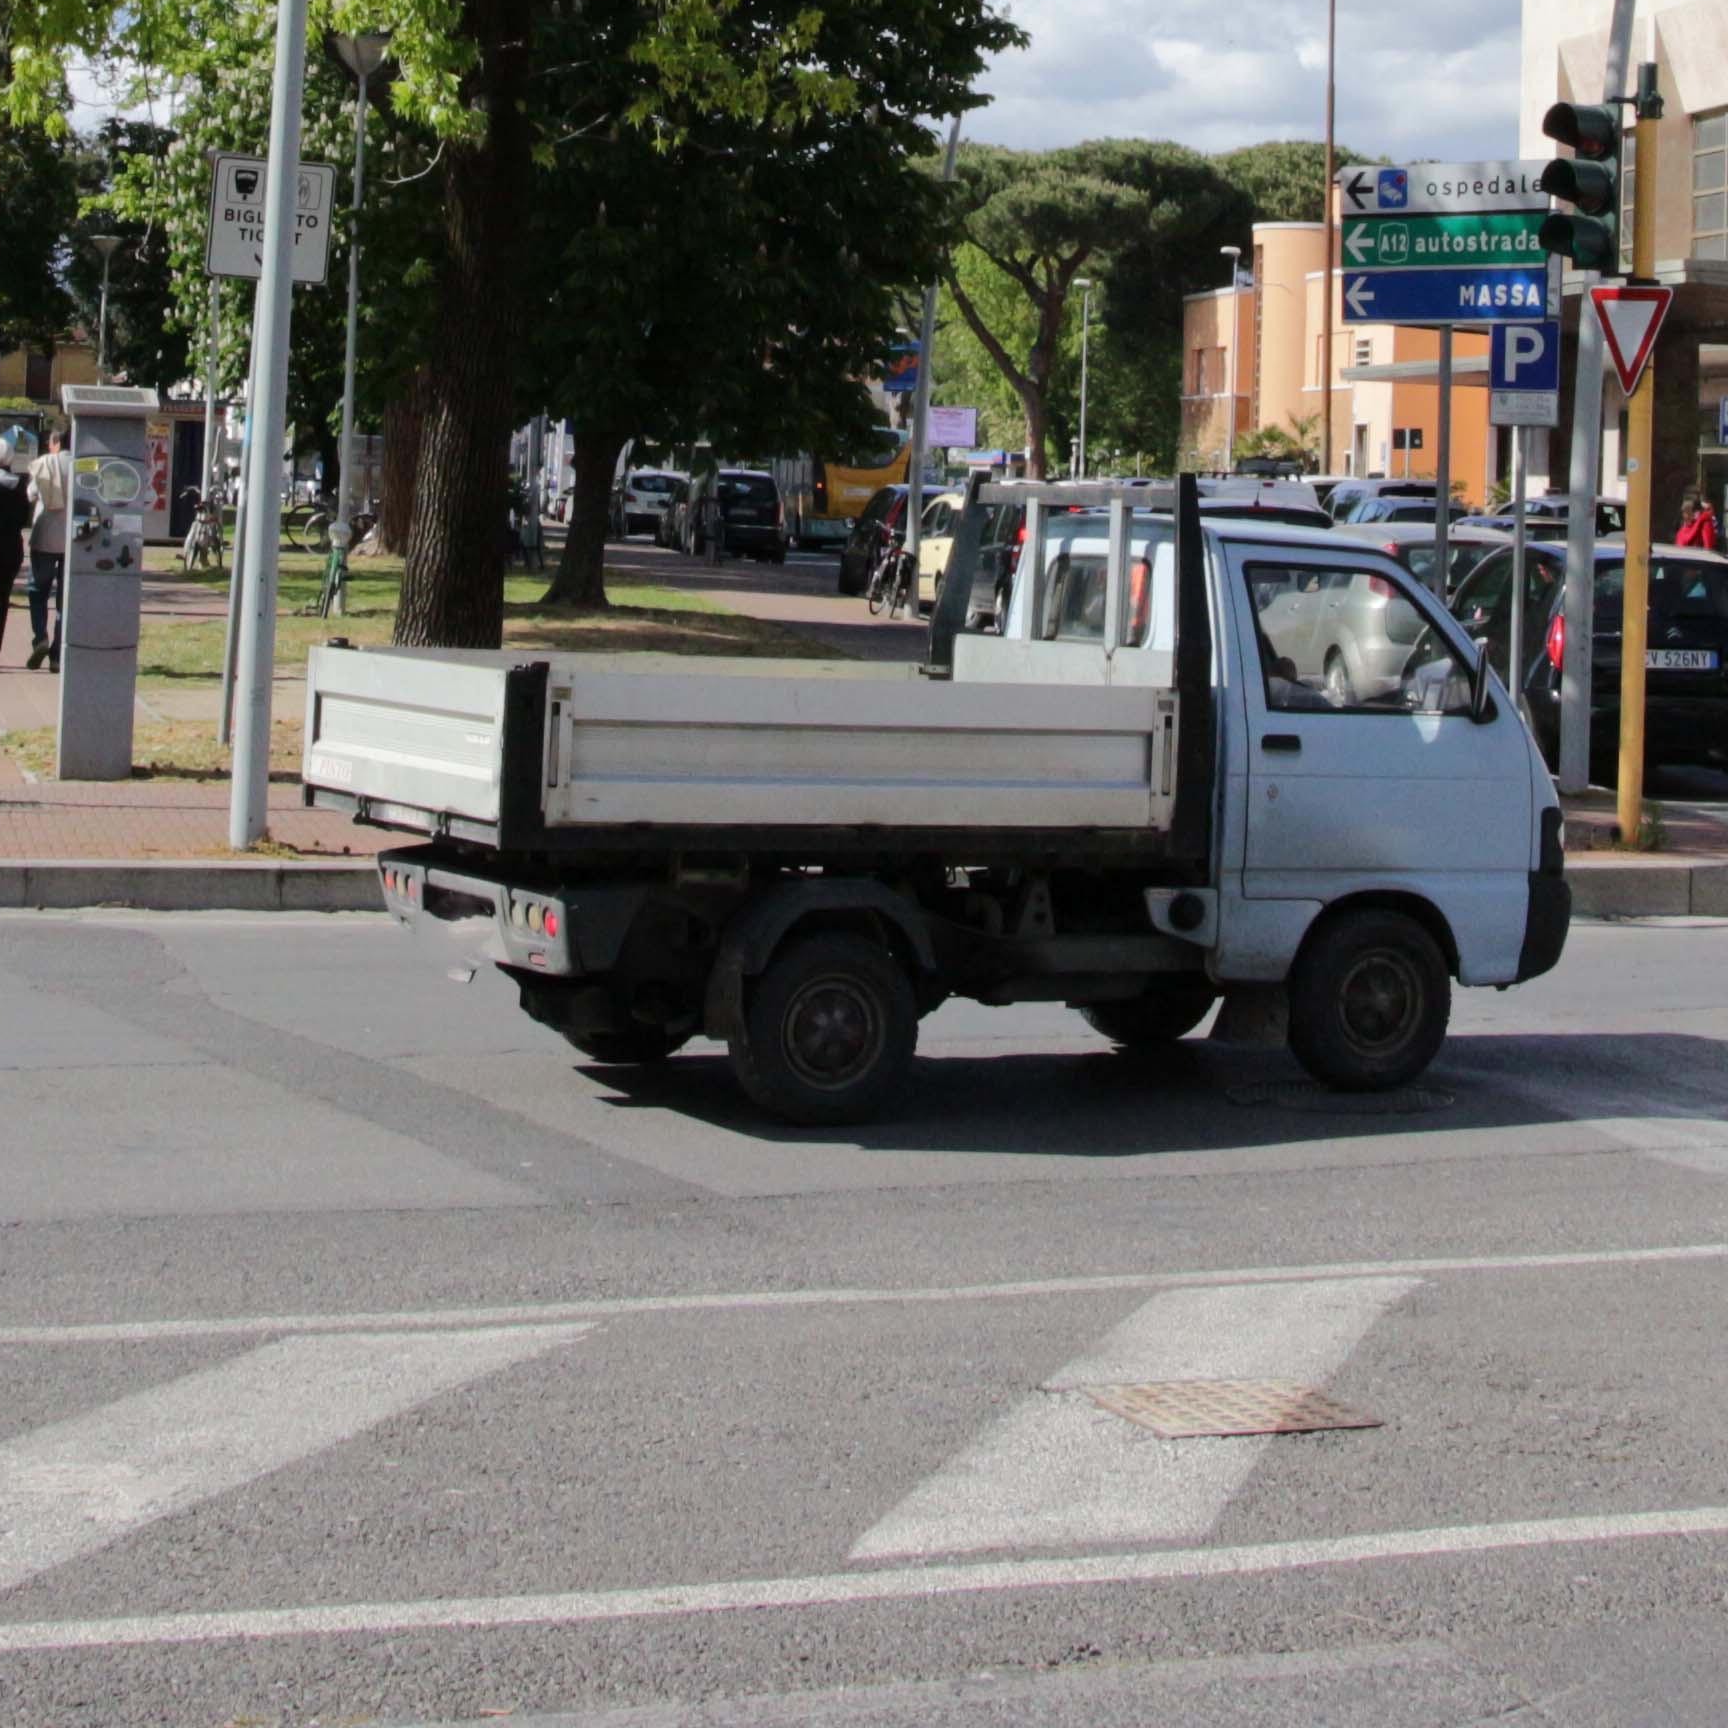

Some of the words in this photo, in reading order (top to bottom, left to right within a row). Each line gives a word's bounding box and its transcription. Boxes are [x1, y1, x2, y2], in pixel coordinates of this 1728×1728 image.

[1426, 174, 1543, 199] ospedale
[224, 208, 319, 229] BIGLTO
[1379, 236, 1408, 253] A12
[1414, 229, 1541, 254] autostrada
[1459, 283, 1541, 308] MASSA
[1504, 326, 1545, 383] P
[1664, 651, 1709, 667] 526NY
